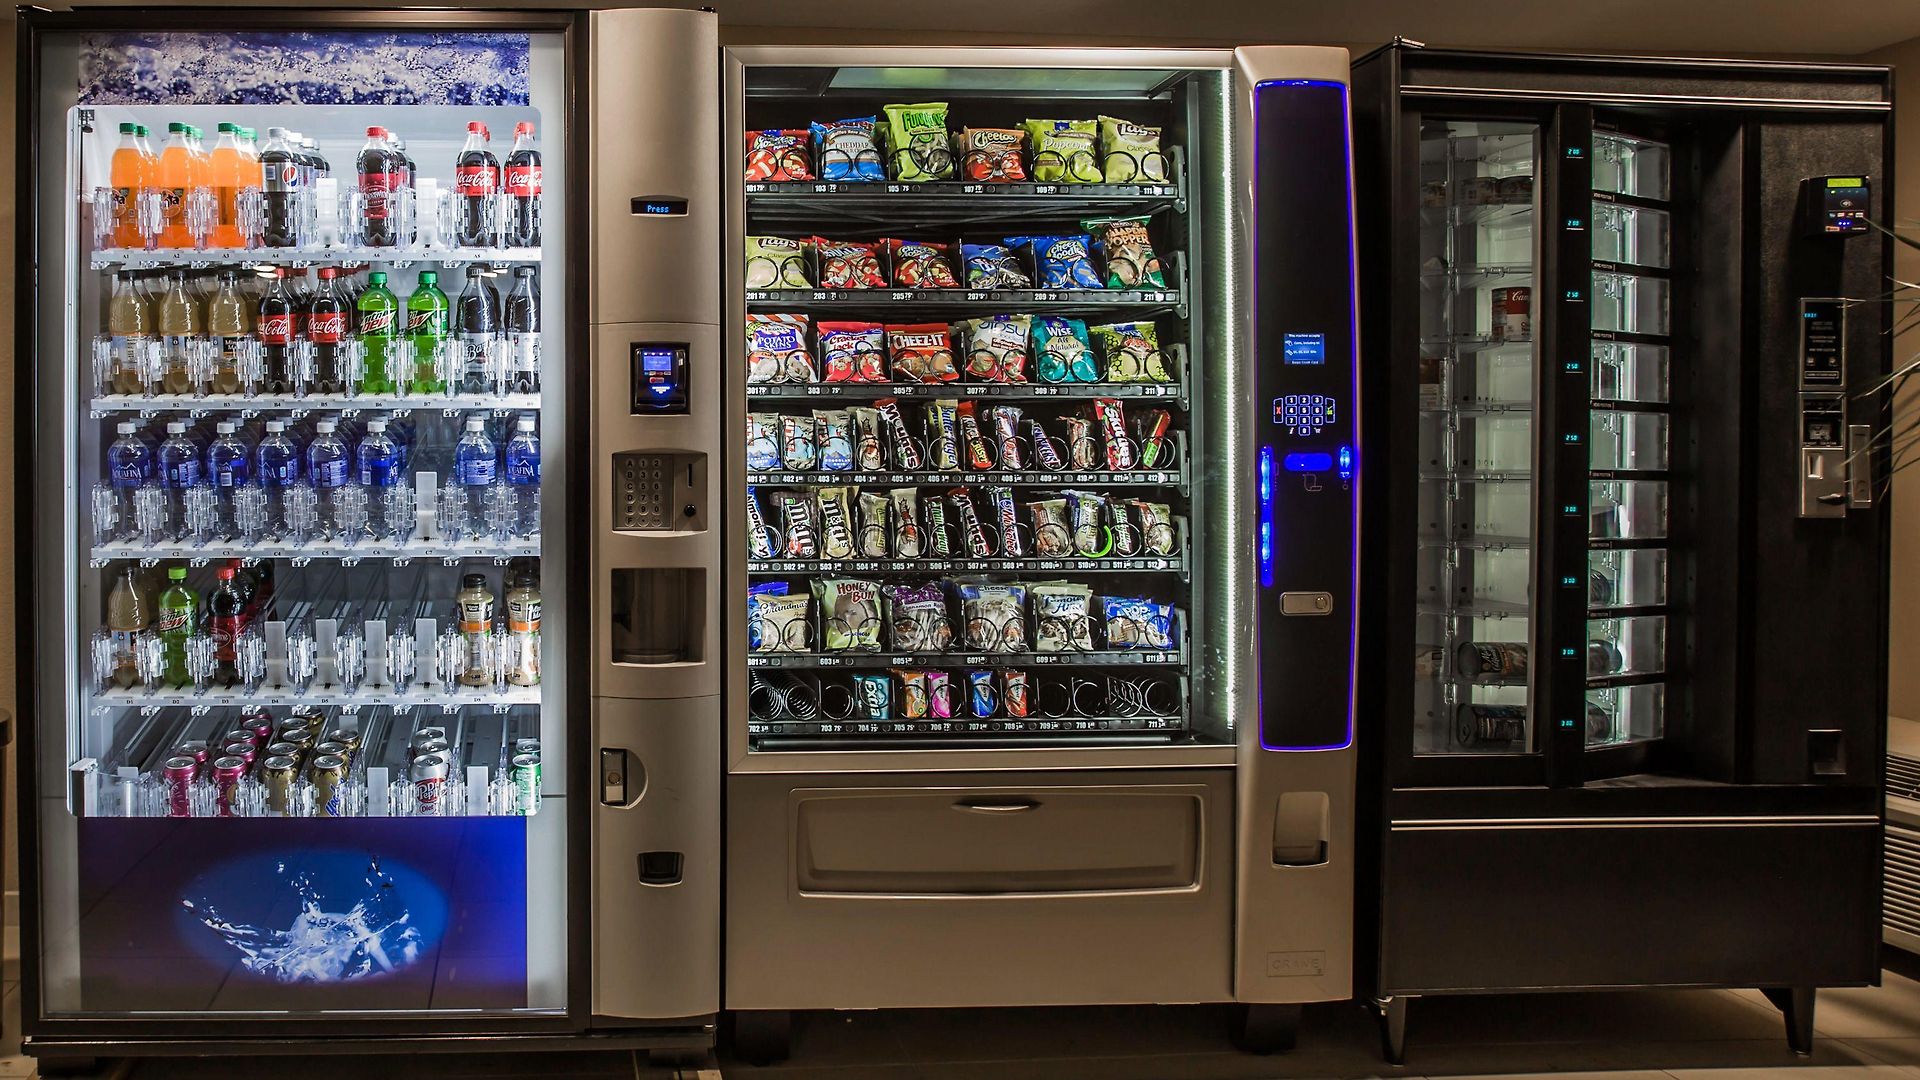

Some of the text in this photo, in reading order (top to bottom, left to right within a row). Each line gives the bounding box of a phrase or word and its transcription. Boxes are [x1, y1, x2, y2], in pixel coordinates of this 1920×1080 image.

[647, 205, 669, 213] Press
[758, 336, 796, 346] POTATO
[765, 342, 792, 350] SKINS
[892, 334, 944, 350] CHEEZ-IT
[880, 403, 918, 469] Mounds
[1106, 407, 1131, 467] Skittles
[958, 496, 985, 556] Mounds
[836, 582, 871, 597] HONEY
[851, 590, 875, 604] BUN
[1272, 959, 1320, 969] CRANE
